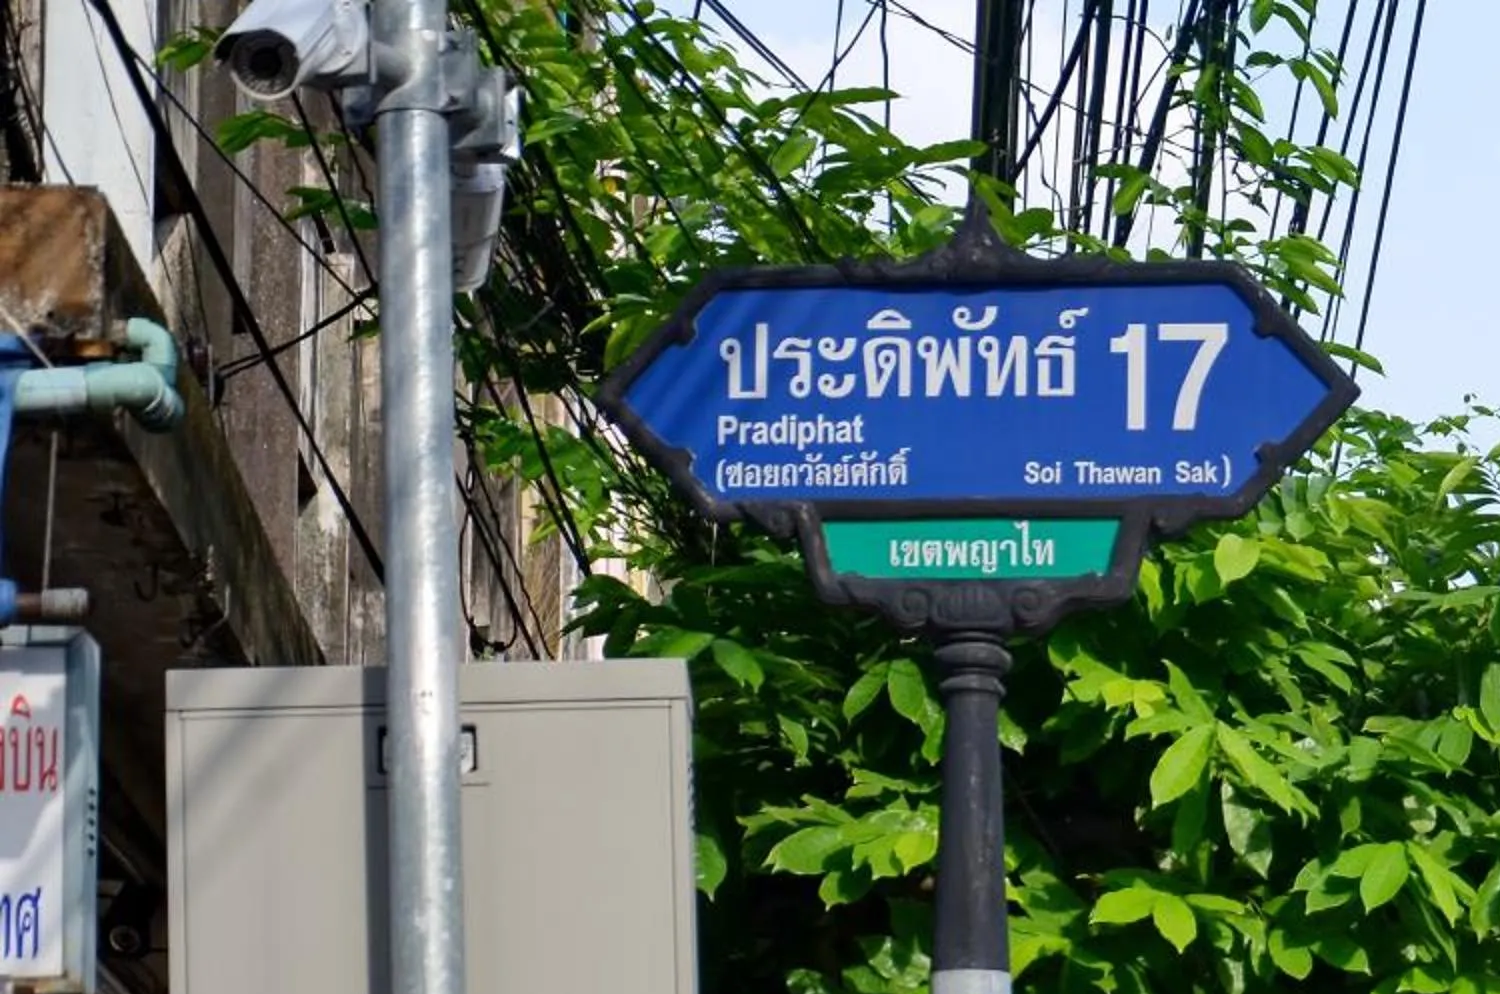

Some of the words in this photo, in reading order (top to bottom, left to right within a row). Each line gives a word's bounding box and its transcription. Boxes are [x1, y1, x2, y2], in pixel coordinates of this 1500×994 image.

[719, 305, 1089, 399] ประดิพัทธ์
[1110, 322, 1230, 431] 17
[717, 413, 864, 450] Pradiphat
[1023, 460, 1062, 484] Soi
[1073, 460, 1162, 485] Thawan
[889, 519, 1055, 573] เขตพญาไท
[0, 694, 58, 792] บิน
